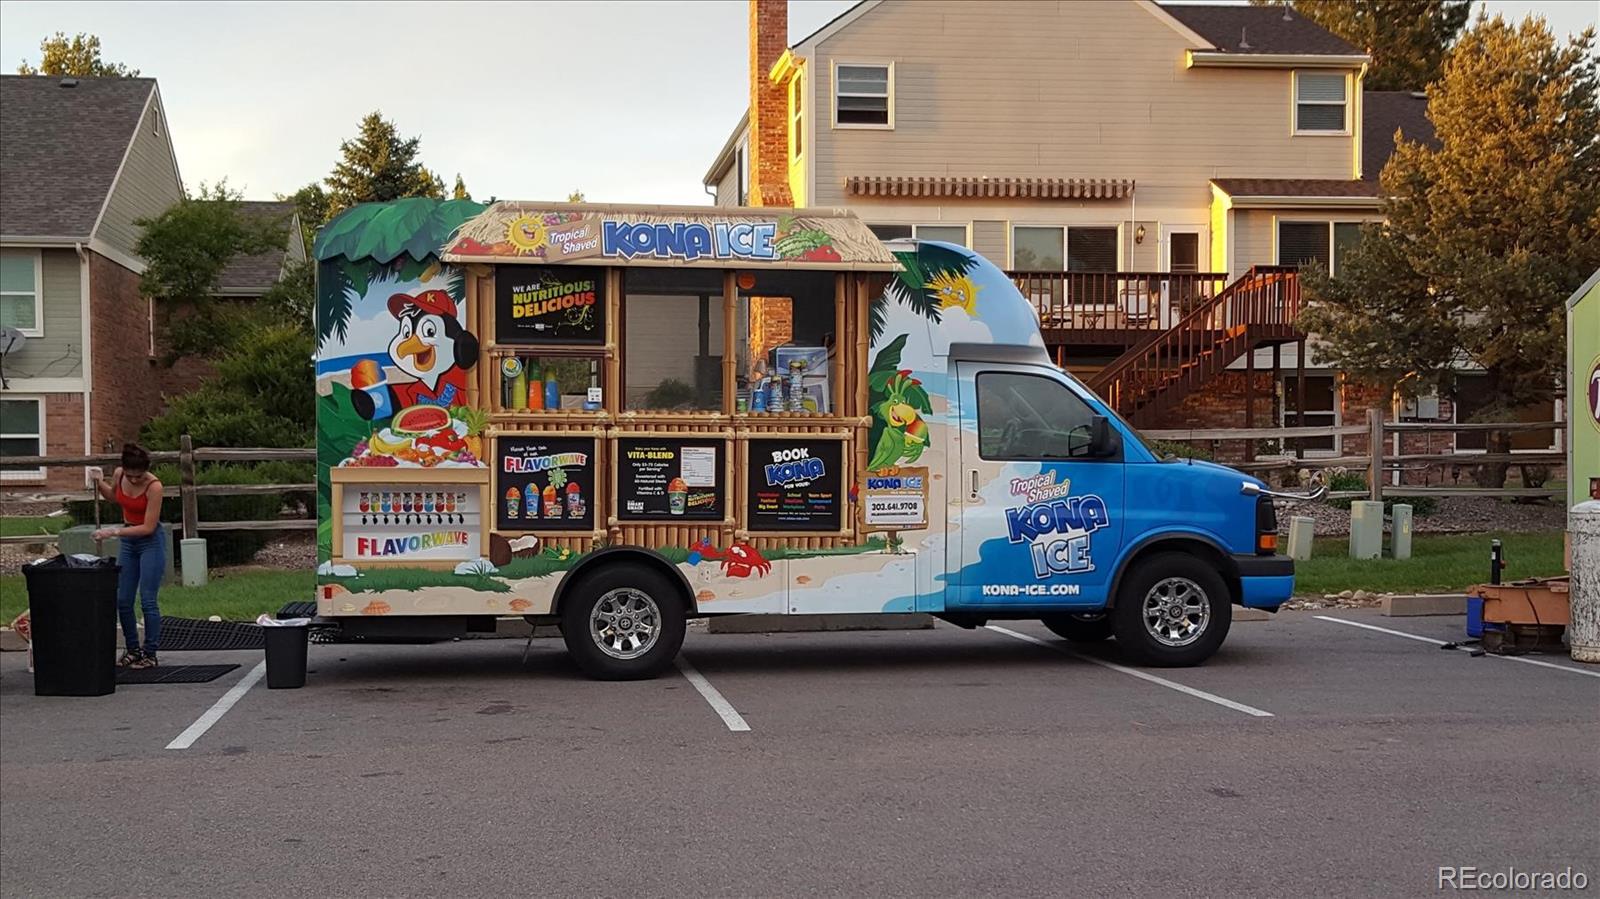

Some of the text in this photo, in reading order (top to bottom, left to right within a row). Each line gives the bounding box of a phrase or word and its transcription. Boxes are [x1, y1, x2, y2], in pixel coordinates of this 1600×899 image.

[551, 222, 590, 246] Tropical
[562, 236, 597, 255] Shaved
[602, 220, 776, 261] KONA ICE
[513, 280, 591, 304] NUTRITIOUS
[526, 283, 540, 292] ARE
[512, 292, 596, 319] DELICIOUS
[505, 453, 586, 473] FLAVORWAVE
[627, 451, 674, 459] VITA-BLEND
[772, 448, 809, 462] BOOK
[765, 457, 825, 486] KONA
[867, 477, 922, 489] KONA ICE
[1010, 470, 1056, 495] Tropical
[1027, 479, 1069, 503] Shaved
[872, 502, 918, 511] 303.641.9708
[1006, 495, 1108, 543] KONA
[357, 531, 468, 556] FLAVORWAVE
[1031, 534, 1090, 578] ICE
[983, 584, 1080, 596] KONA-ICE.COM
